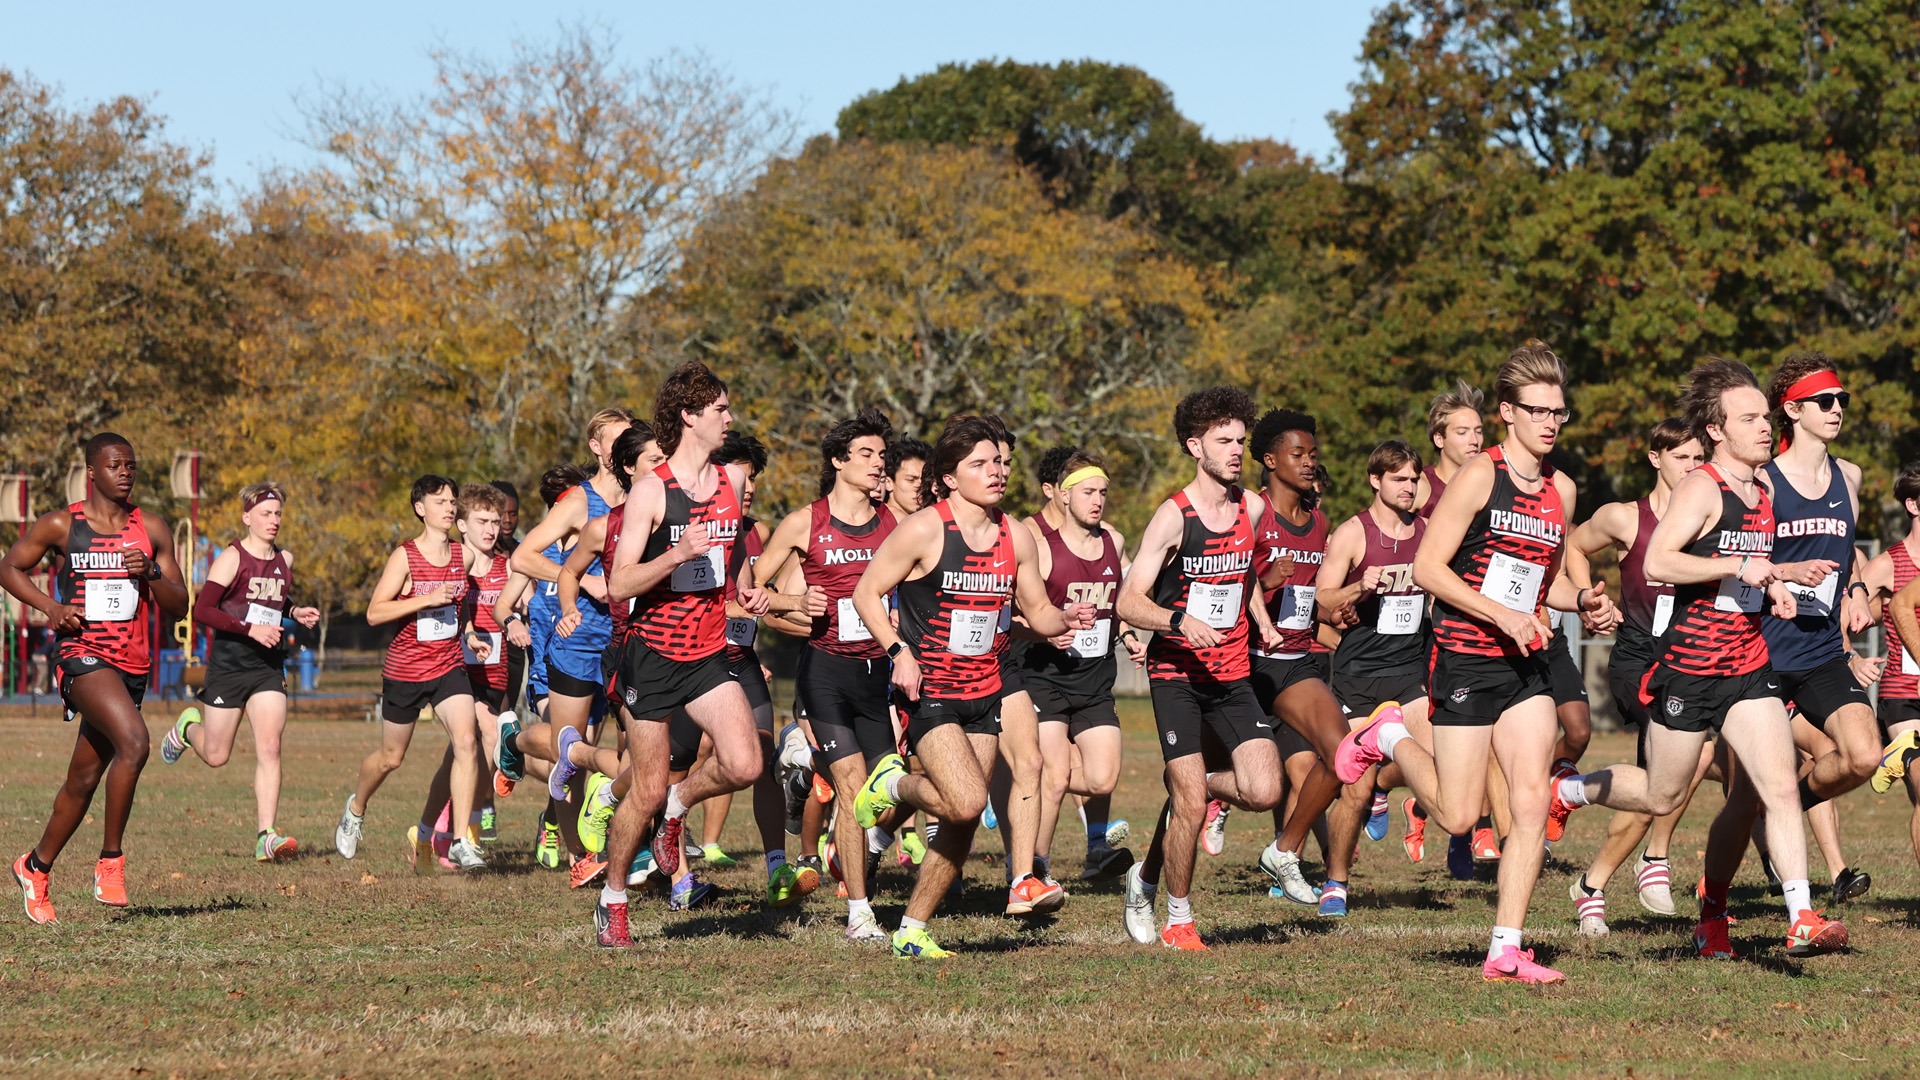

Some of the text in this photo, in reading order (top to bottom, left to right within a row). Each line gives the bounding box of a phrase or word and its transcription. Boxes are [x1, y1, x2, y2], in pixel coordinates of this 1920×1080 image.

[1777, 517, 1847, 538] QUEENS
[823, 548, 874, 566] MOLL
[694, 567, 706, 578] 73
[1376, 563, 1424, 594] STA
[245, 577, 285, 602] STAC
[1509, 580, 1522, 595] 76
[1740, 585, 1751, 598] 77
[1063, 582, 1117, 609] STAC
[1798, 590, 1816, 602] 80
[107, 597, 120, 608] 75
[1210, 604, 1223, 615] 74
[1297, 606, 1310, 616] 156
[1395, 612, 1411, 623] 110
[434, 622, 444, 631] 87
[731, 622, 747, 634] 150
[970, 630, 982, 642] 72
[1081, 636, 1098, 647] 109
